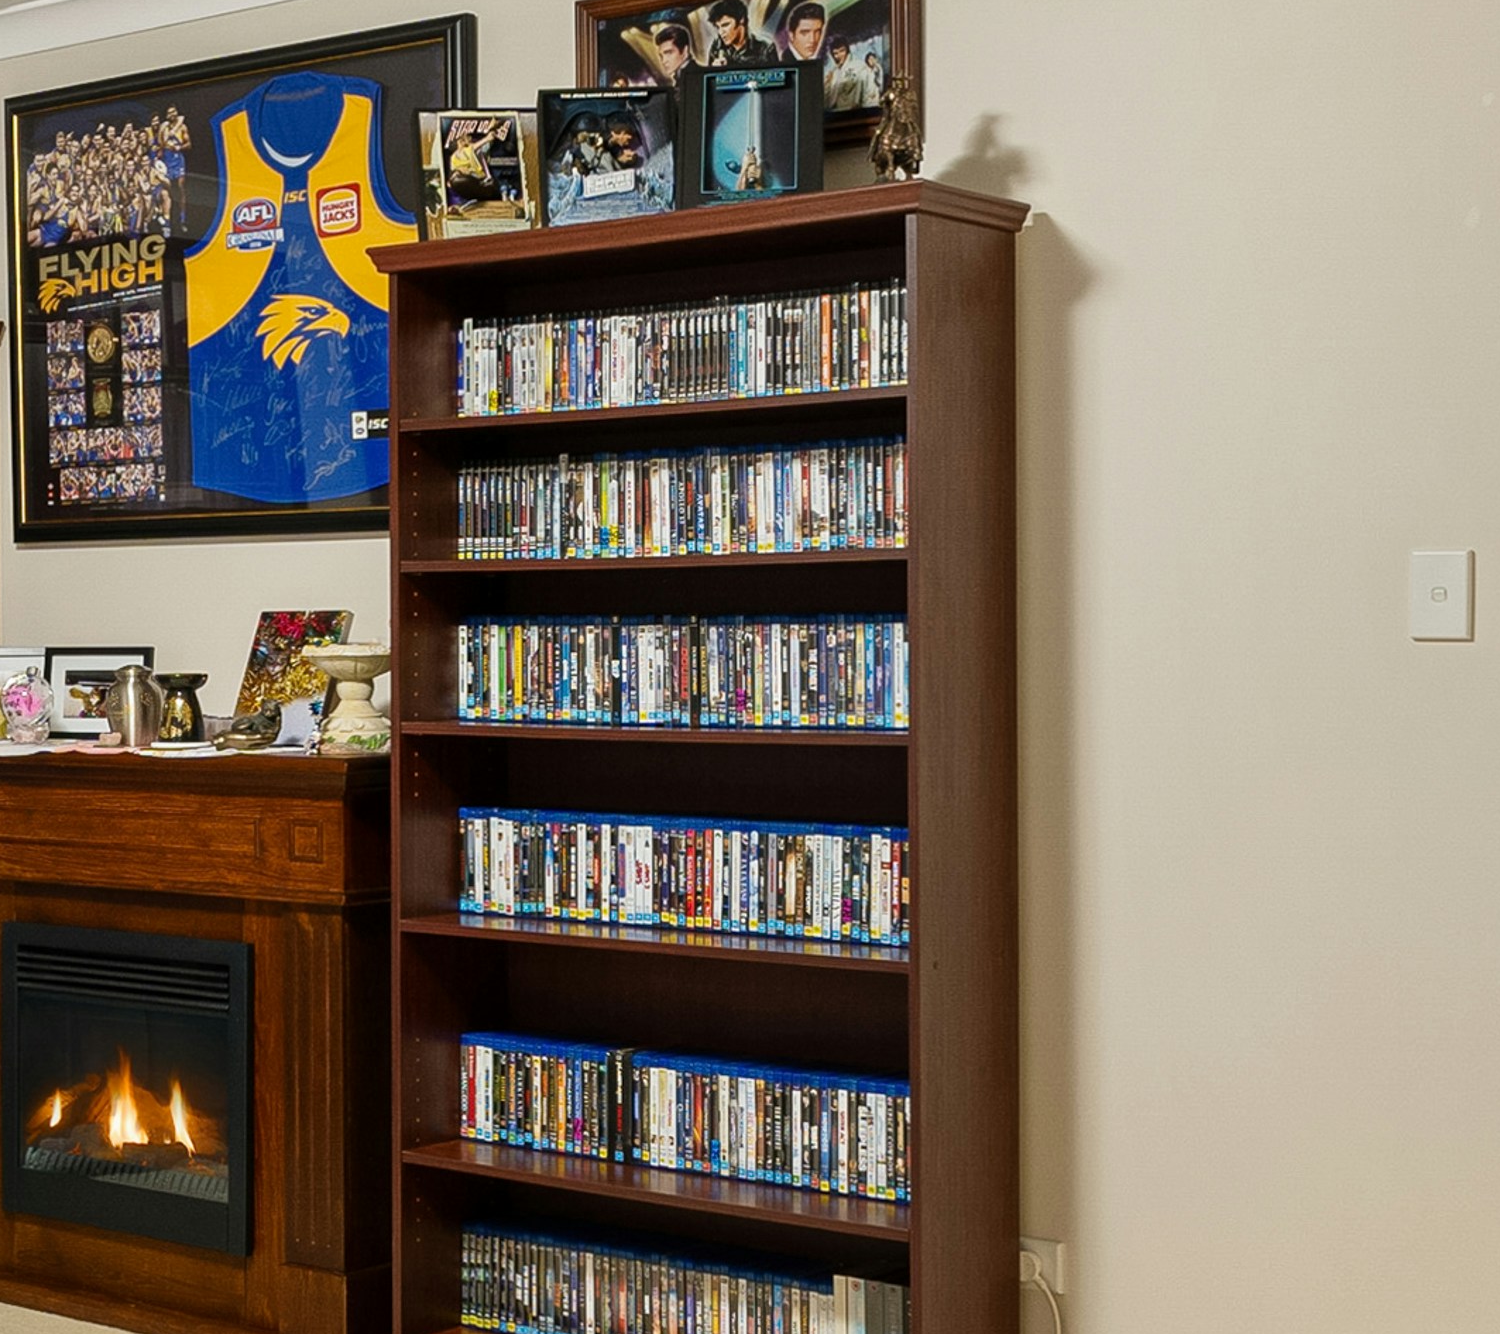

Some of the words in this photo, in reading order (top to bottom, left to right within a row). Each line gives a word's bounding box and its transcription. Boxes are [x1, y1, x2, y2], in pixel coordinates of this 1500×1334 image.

[284, 189, 308, 204] ISC
[322, 200, 355, 212] HUNGRY
[237, 206, 273, 223] AFL
[38, 234, 167, 282] FLYING
[74, 257, 164, 296] HIGH
[368, 418, 389, 430] ISC
